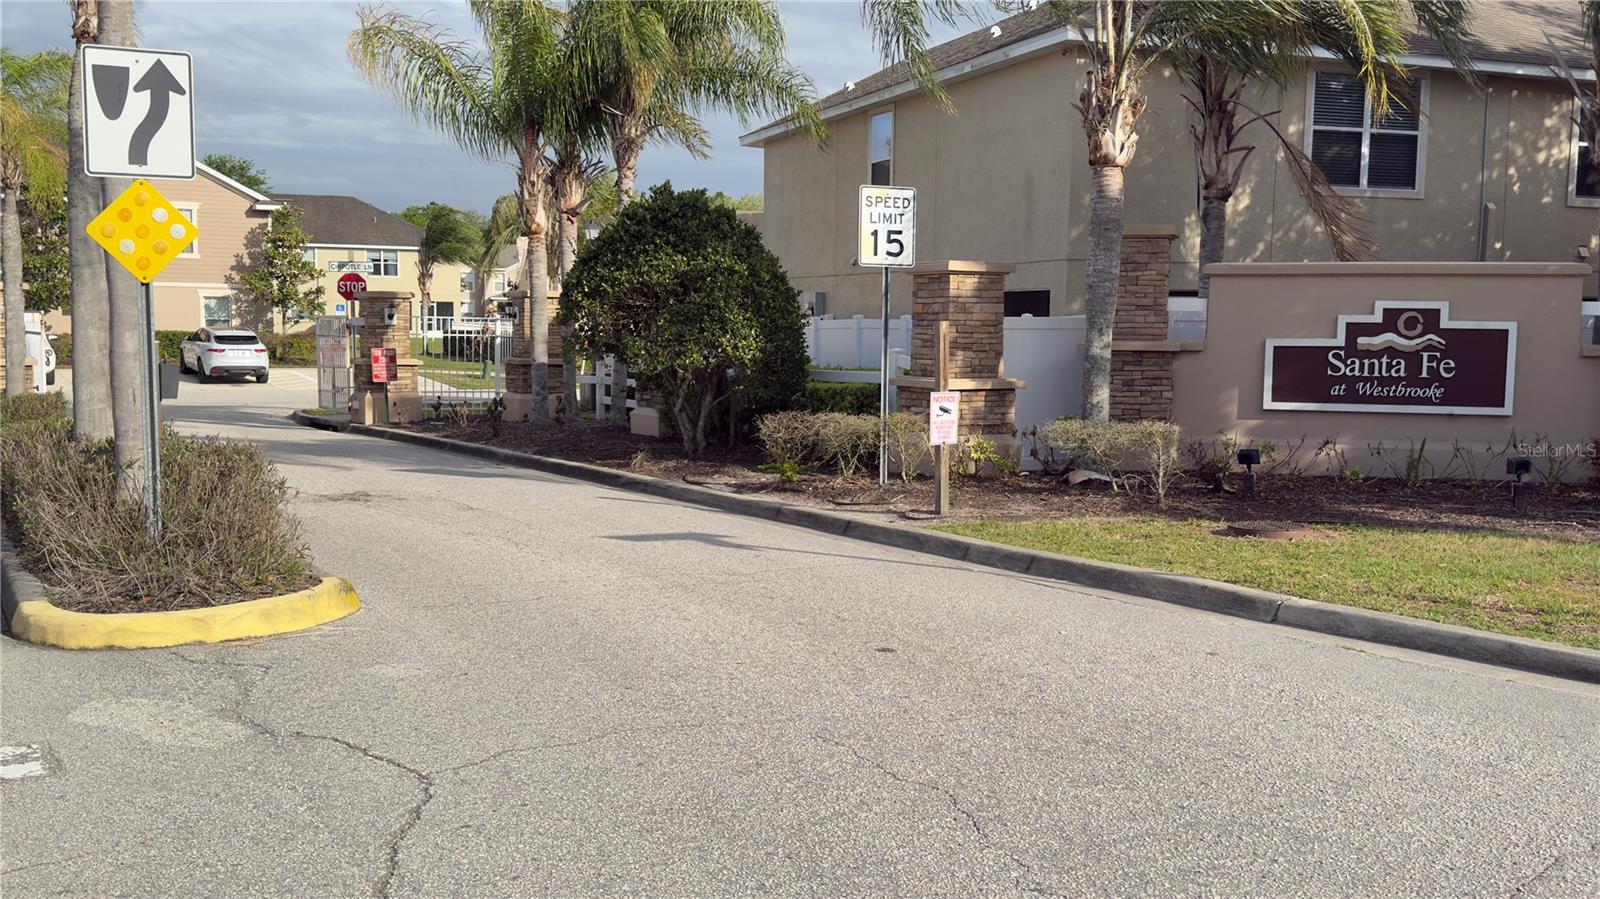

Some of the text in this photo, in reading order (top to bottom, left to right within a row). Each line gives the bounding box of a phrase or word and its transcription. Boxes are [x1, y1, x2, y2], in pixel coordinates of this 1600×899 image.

[865, 195, 911, 209] SPEED
[869, 212, 905, 225] LIMIT
[870, 229, 905, 258] 15
[330, 263, 373, 271] CHIPOTLE LN
[339, 281, 365, 292] STOP
[1327, 350, 1456, 379] Santa Fe
[1330, 380, 1445, 402] at Westbrooke
[933, 395, 957, 403] NOTICE
